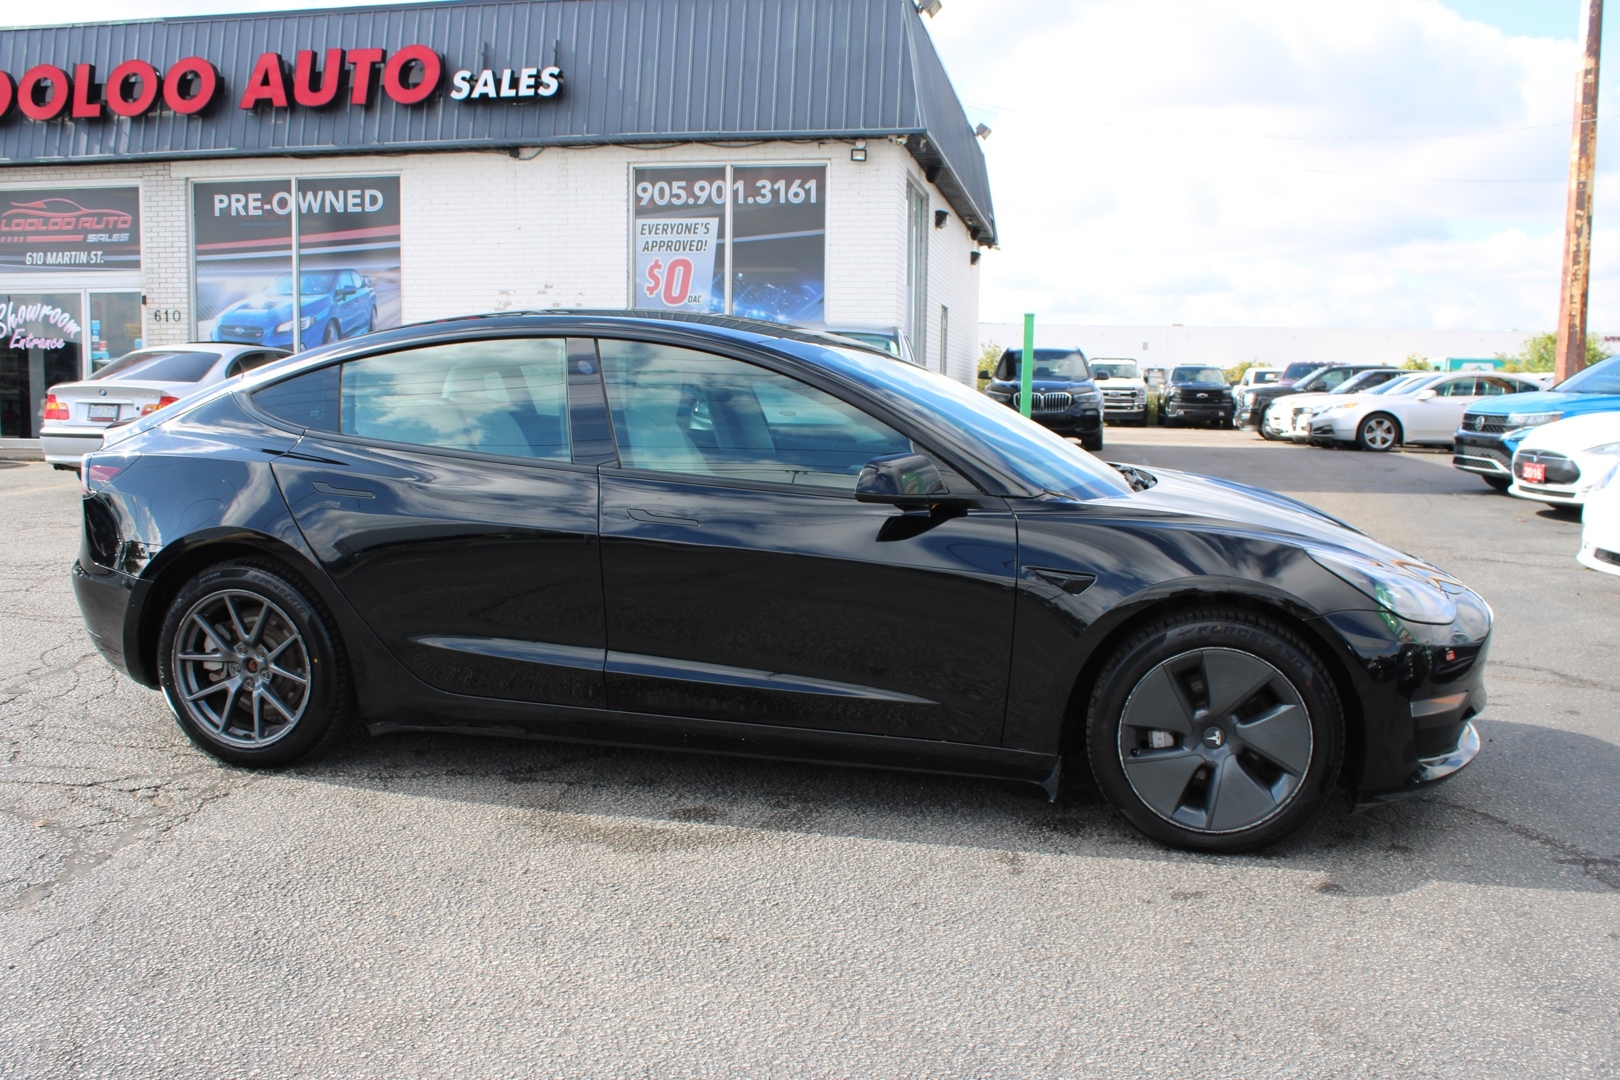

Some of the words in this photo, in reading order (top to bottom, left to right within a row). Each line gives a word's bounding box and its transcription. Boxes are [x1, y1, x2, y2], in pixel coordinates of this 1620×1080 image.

[0, 56, 216, 121] OLOO
[239, 44, 441, 109] AUTO
[450, 66, 561, 100] SALES
[636, 179, 817, 206] 905.901.3161
[213, 189, 384, 216] PRE-OWNED
[0, 217, 76, 231] LOOLOO
[78, 216, 132, 230] AUTO
[640, 222, 711, 235] EVERYONE'S
[86, 233, 130, 242] SALES
[642, 239, 708, 252] APPROVED!
[25, 252, 44, 265] 610
[46, 251, 88, 264] MARTIN
[90, 251, 104, 263] ST.
[646, 258, 692, 305] $0
[687, 295, 702, 303] OAC
[154, 309, 181, 323] 610
[9, 328, 65, 350] Entrance
[1523, 466, 1542, 480] 2016
